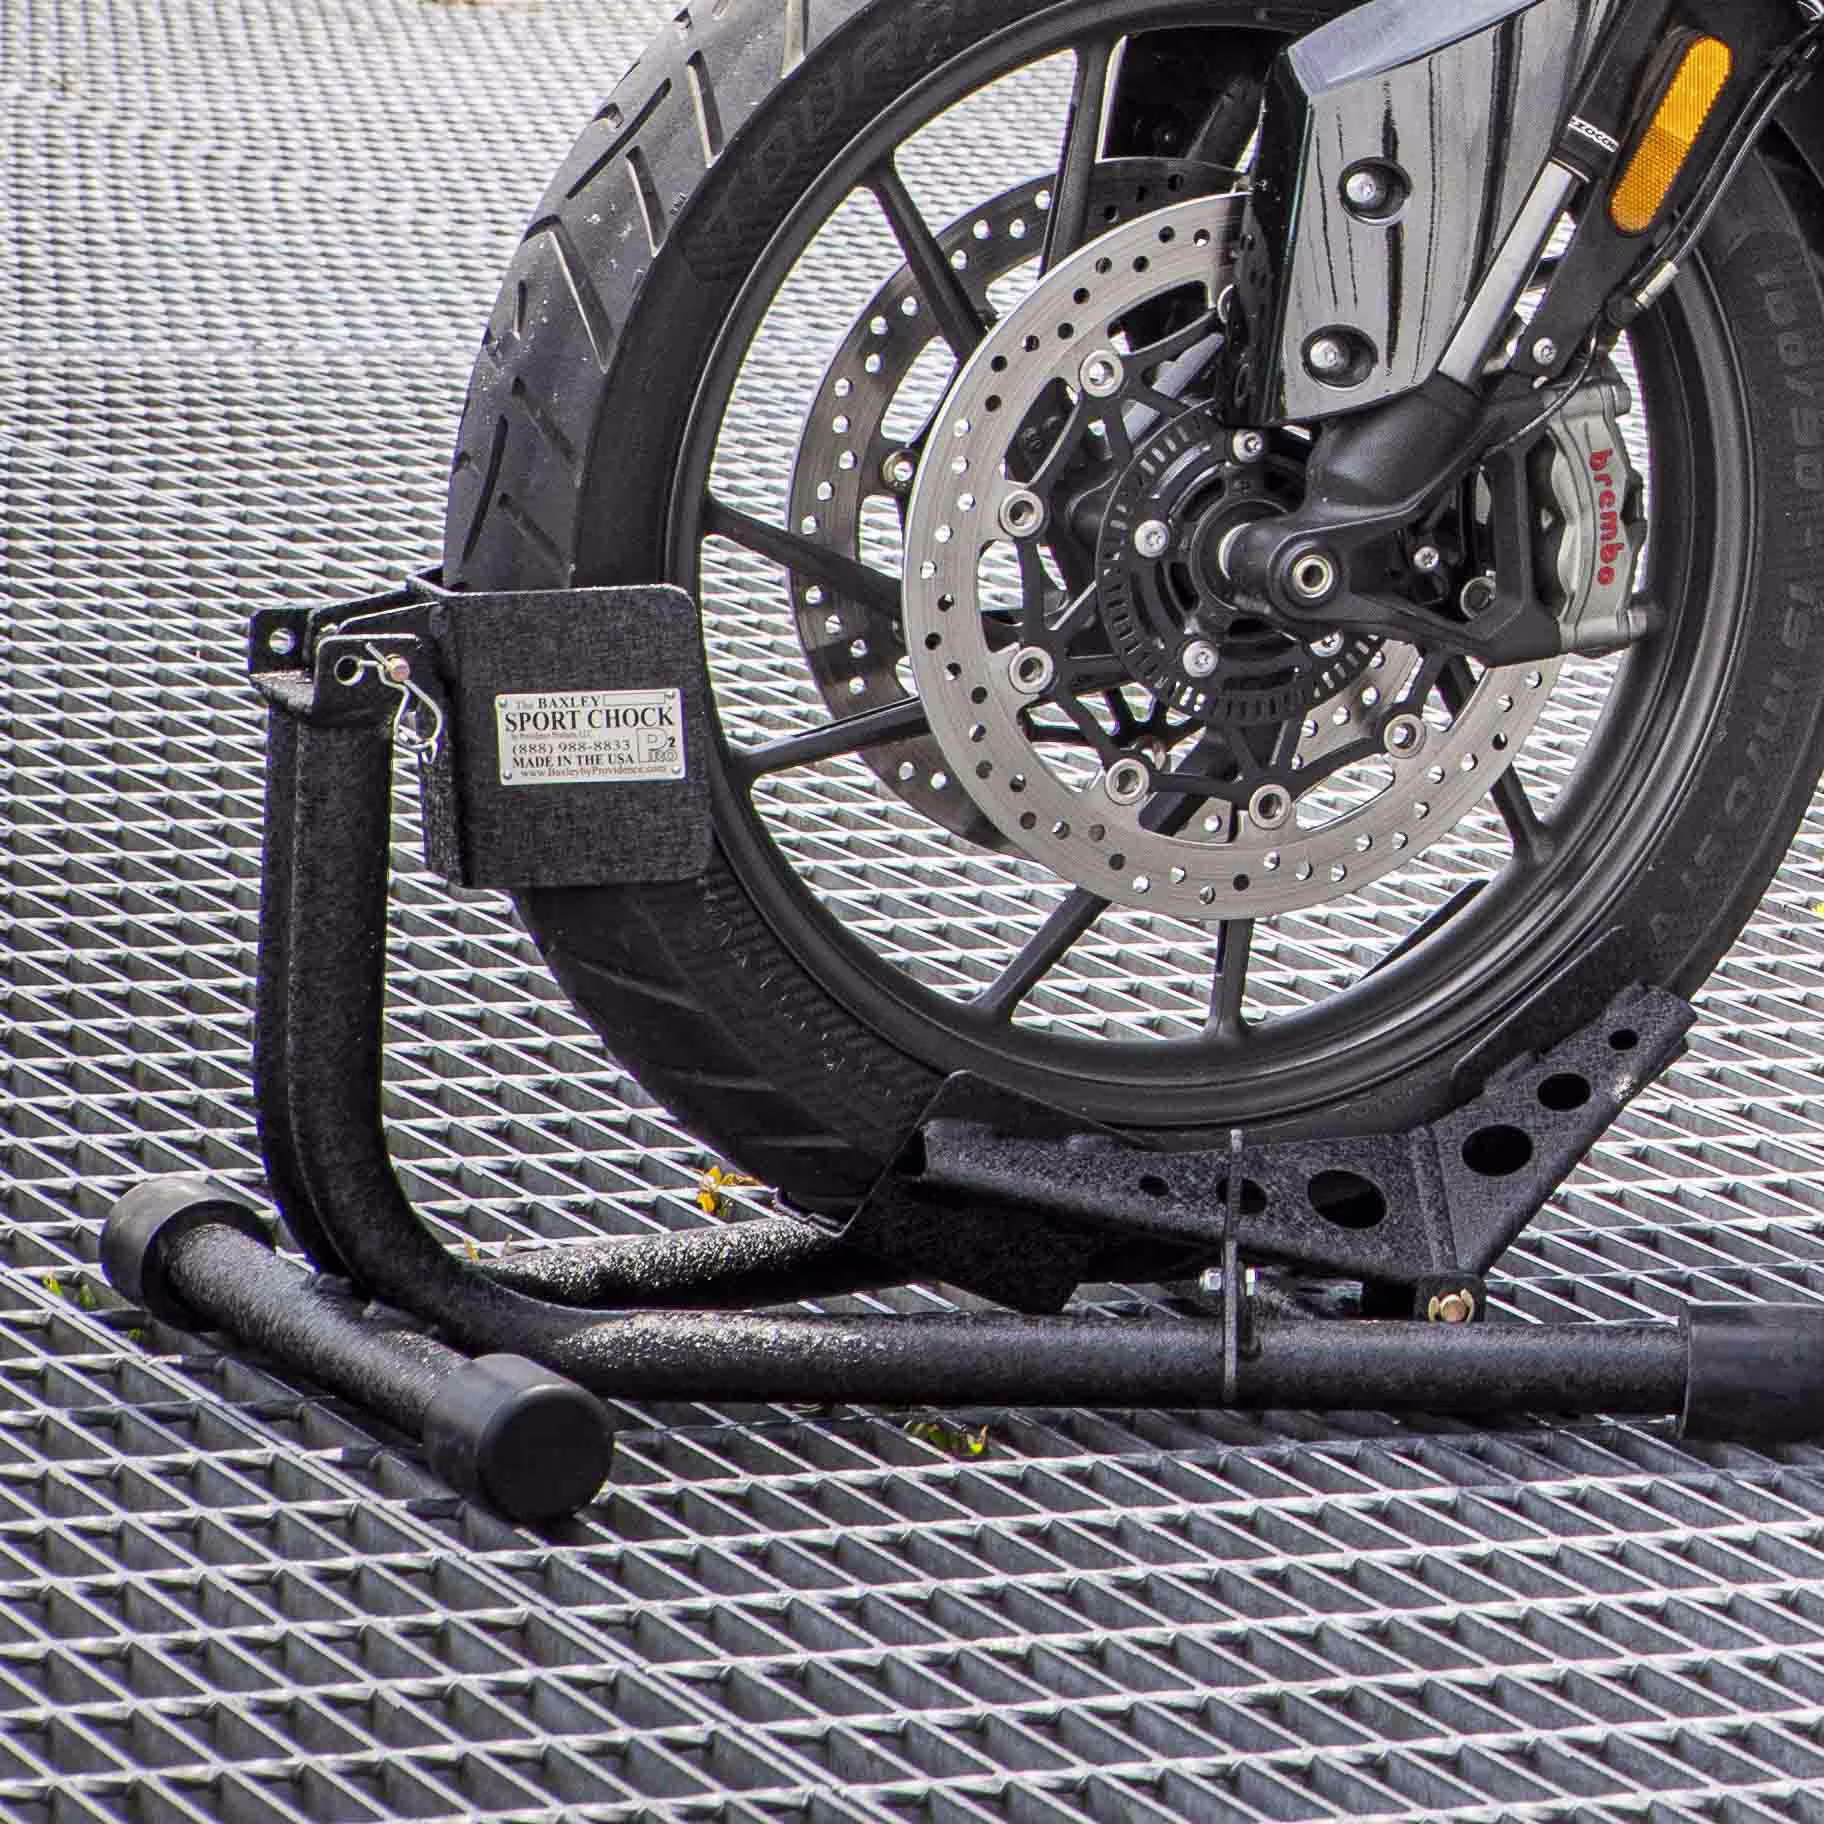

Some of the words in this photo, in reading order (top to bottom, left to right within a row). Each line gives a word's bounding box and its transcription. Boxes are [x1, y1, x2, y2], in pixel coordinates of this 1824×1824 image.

[1589, 448, 1624, 586] brembo
[538, 695, 600, 709] BAXLEY
[505, 710, 581, 732] SPORT
[588, 707, 673, 729] CHOCK
[512, 742, 553, 754] (888)
[558, 739, 631, 752] 988-8833
[512, 755, 555, 768] MADE
[557, 754, 572, 767] IN
[575, 754, 606, 767] THE
[608, 752, 634, 765] USA
